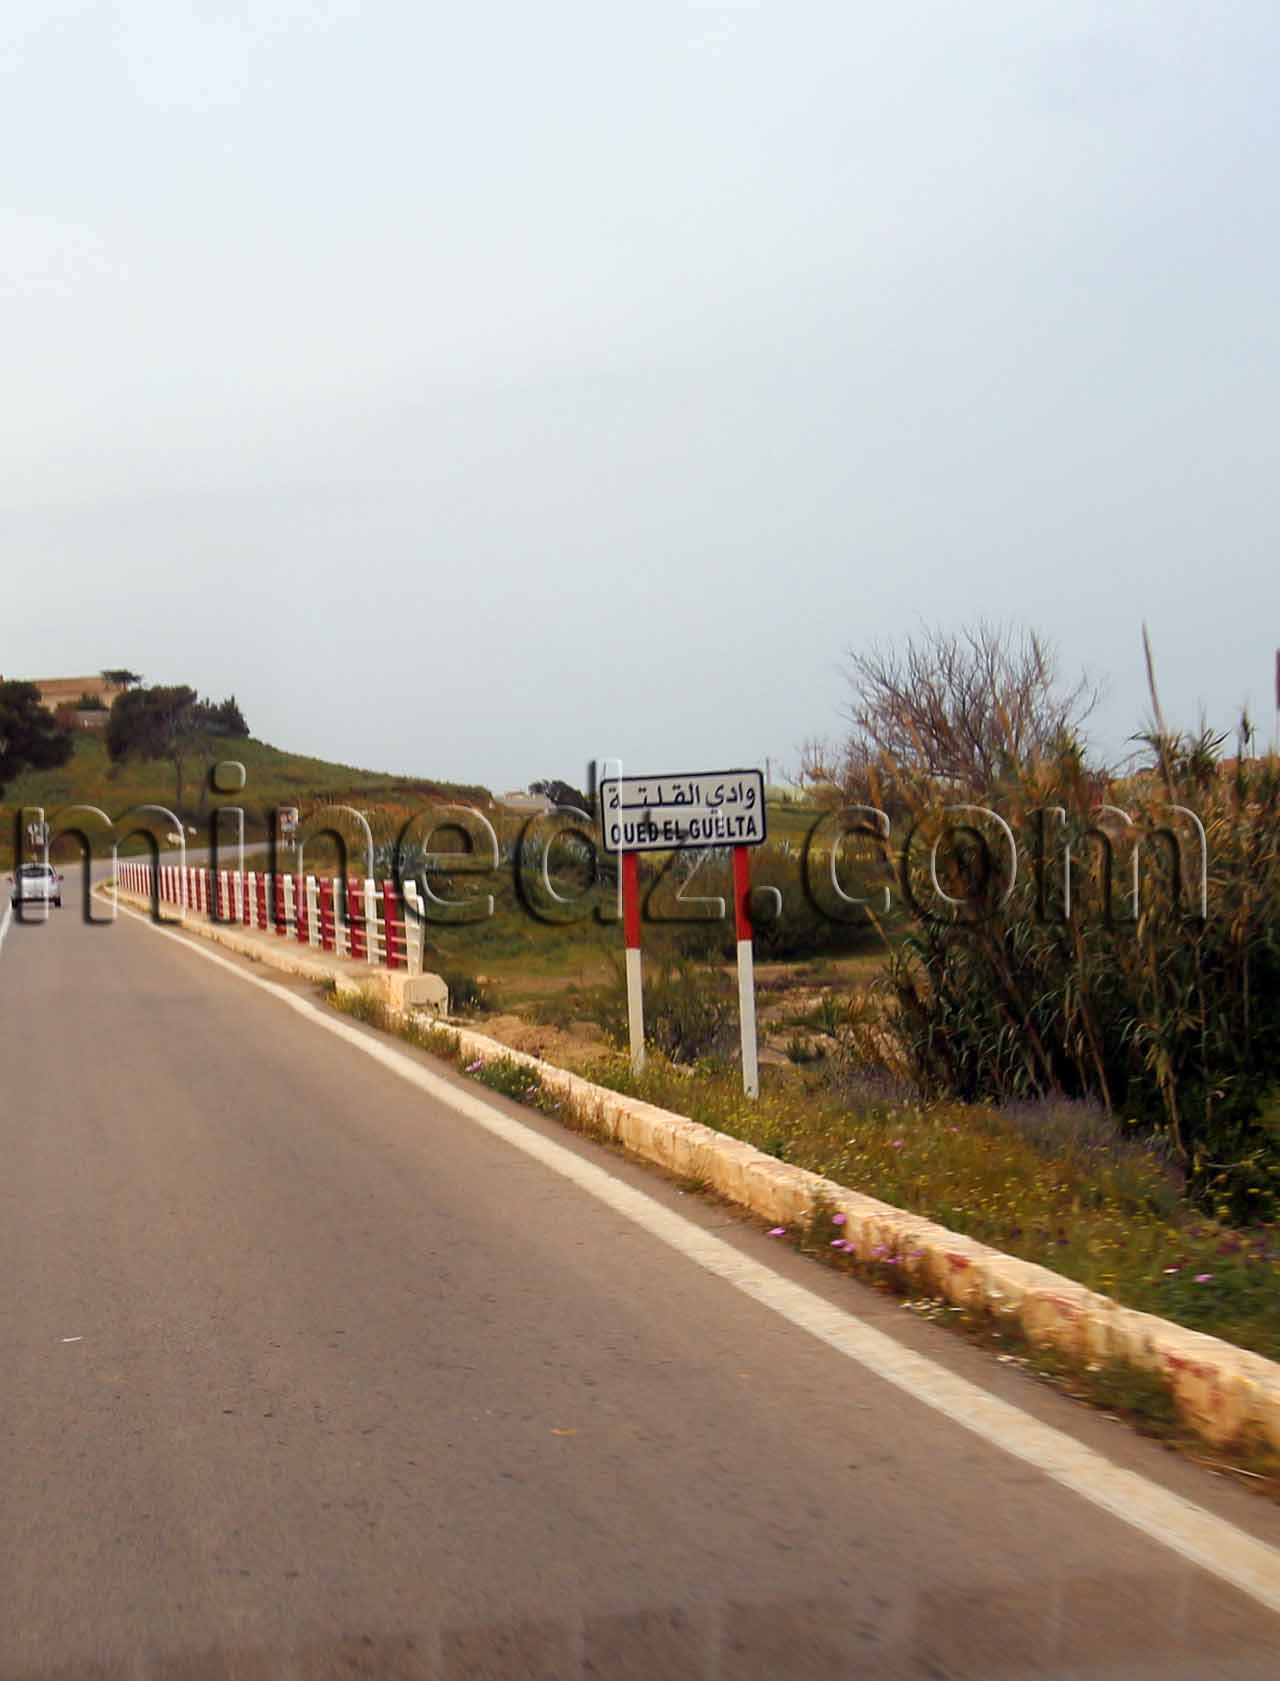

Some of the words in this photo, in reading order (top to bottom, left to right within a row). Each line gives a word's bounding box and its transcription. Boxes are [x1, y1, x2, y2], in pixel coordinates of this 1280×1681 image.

[610, 823, 658, 845] OUED
[663, 819, 684, 840] EL
[688, 816, 757, 840] GUELTA
